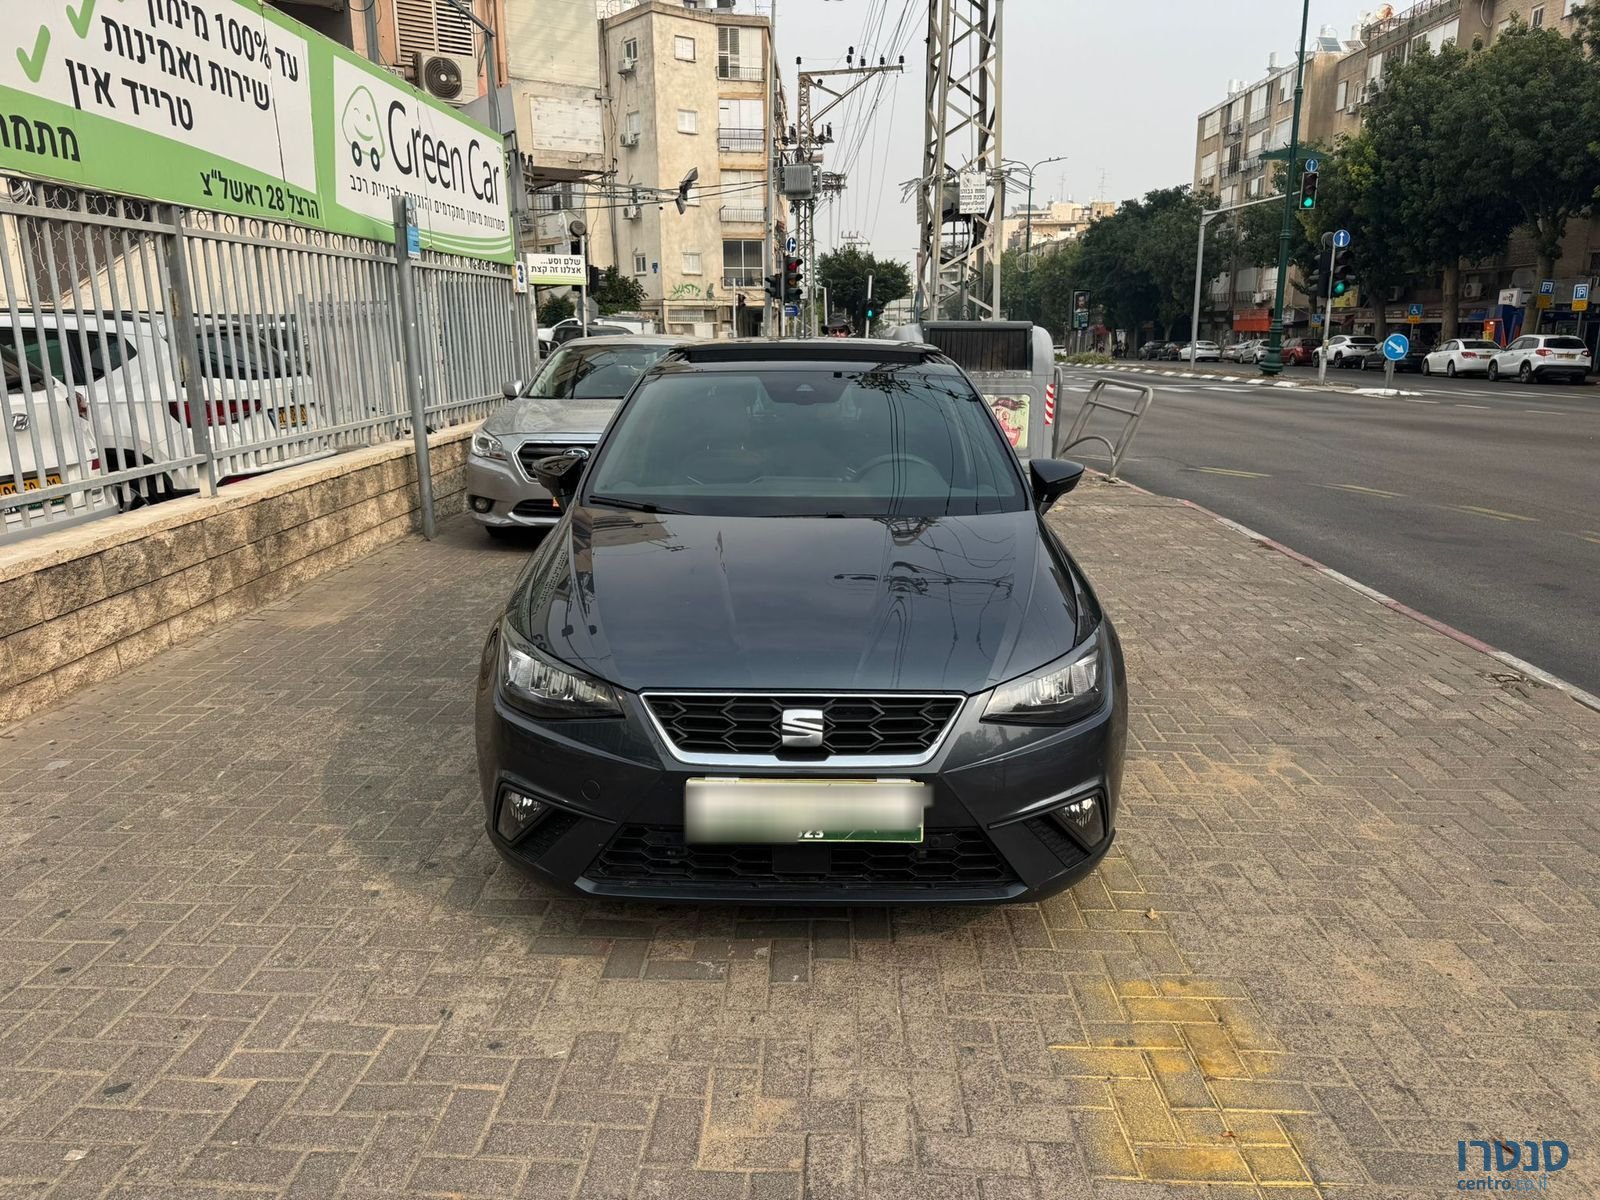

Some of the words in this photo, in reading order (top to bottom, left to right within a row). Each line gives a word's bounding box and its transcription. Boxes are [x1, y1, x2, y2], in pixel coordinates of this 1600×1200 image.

[147, 0, 210, 42] מימון
[100, 14, 203, 87] ואמינות
[215, 13, 272, 70] 100%
[274, 47, 299, 82] עד
[65, 58, 116, 110] אין
[207, 60, 270, 111] שירות
[121, 76, 194, 131] טרייד
[388, 100, 466, 194] Green
[468, 139, 500, 206] Car
[266, 184, 285, 212] 28
[349, 174, 370, 195] רכב
[287, 187, 320, 220] הרצל
[530, 265, 548, 274] קצת
[549, 265, 559, 273] זה
[560, 265, 582, 274] אצלנו
[563, 257, 582, 266] שלם
